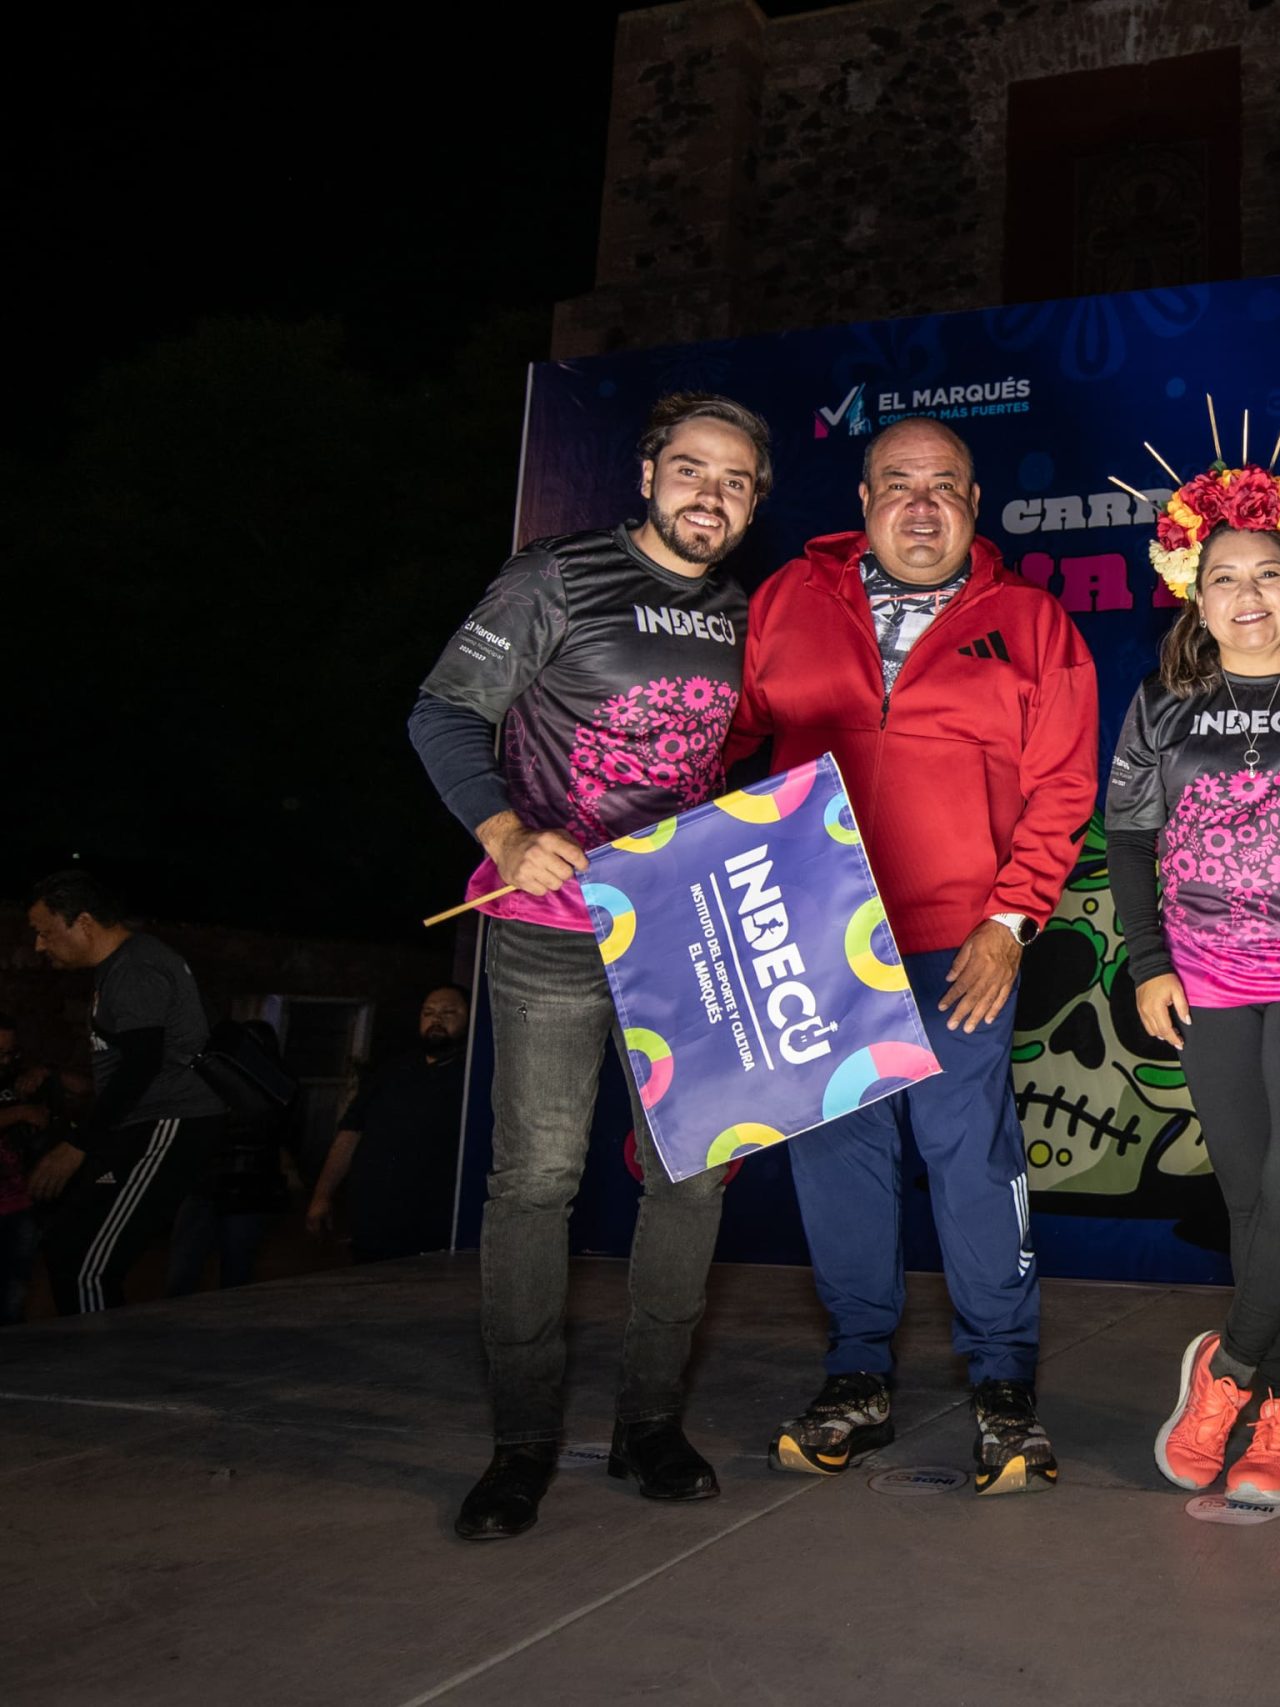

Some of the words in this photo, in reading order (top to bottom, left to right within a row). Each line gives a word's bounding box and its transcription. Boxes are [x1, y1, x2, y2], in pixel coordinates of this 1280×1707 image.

[878, 393, 906, 411] EL
[912, 376, 1031, 408] MARQUÉS
[940, 406, 968, 419] MÁS
[971, 401, 1029, 417] FUERTES
[473, 624, 511, 651] Marqués
[690, 883, 715, 938] INSTITUTO
[688, 943, 702, 961] EL
[707, 937, 718, 963] DEL
[694, 960, 723, 1025] MARQUÉS
[713, 960, 737, 1014] DEPORTE
[728, 1010, 739, 1020] Y
[731, 1019, 755, 1072] CULTURA
